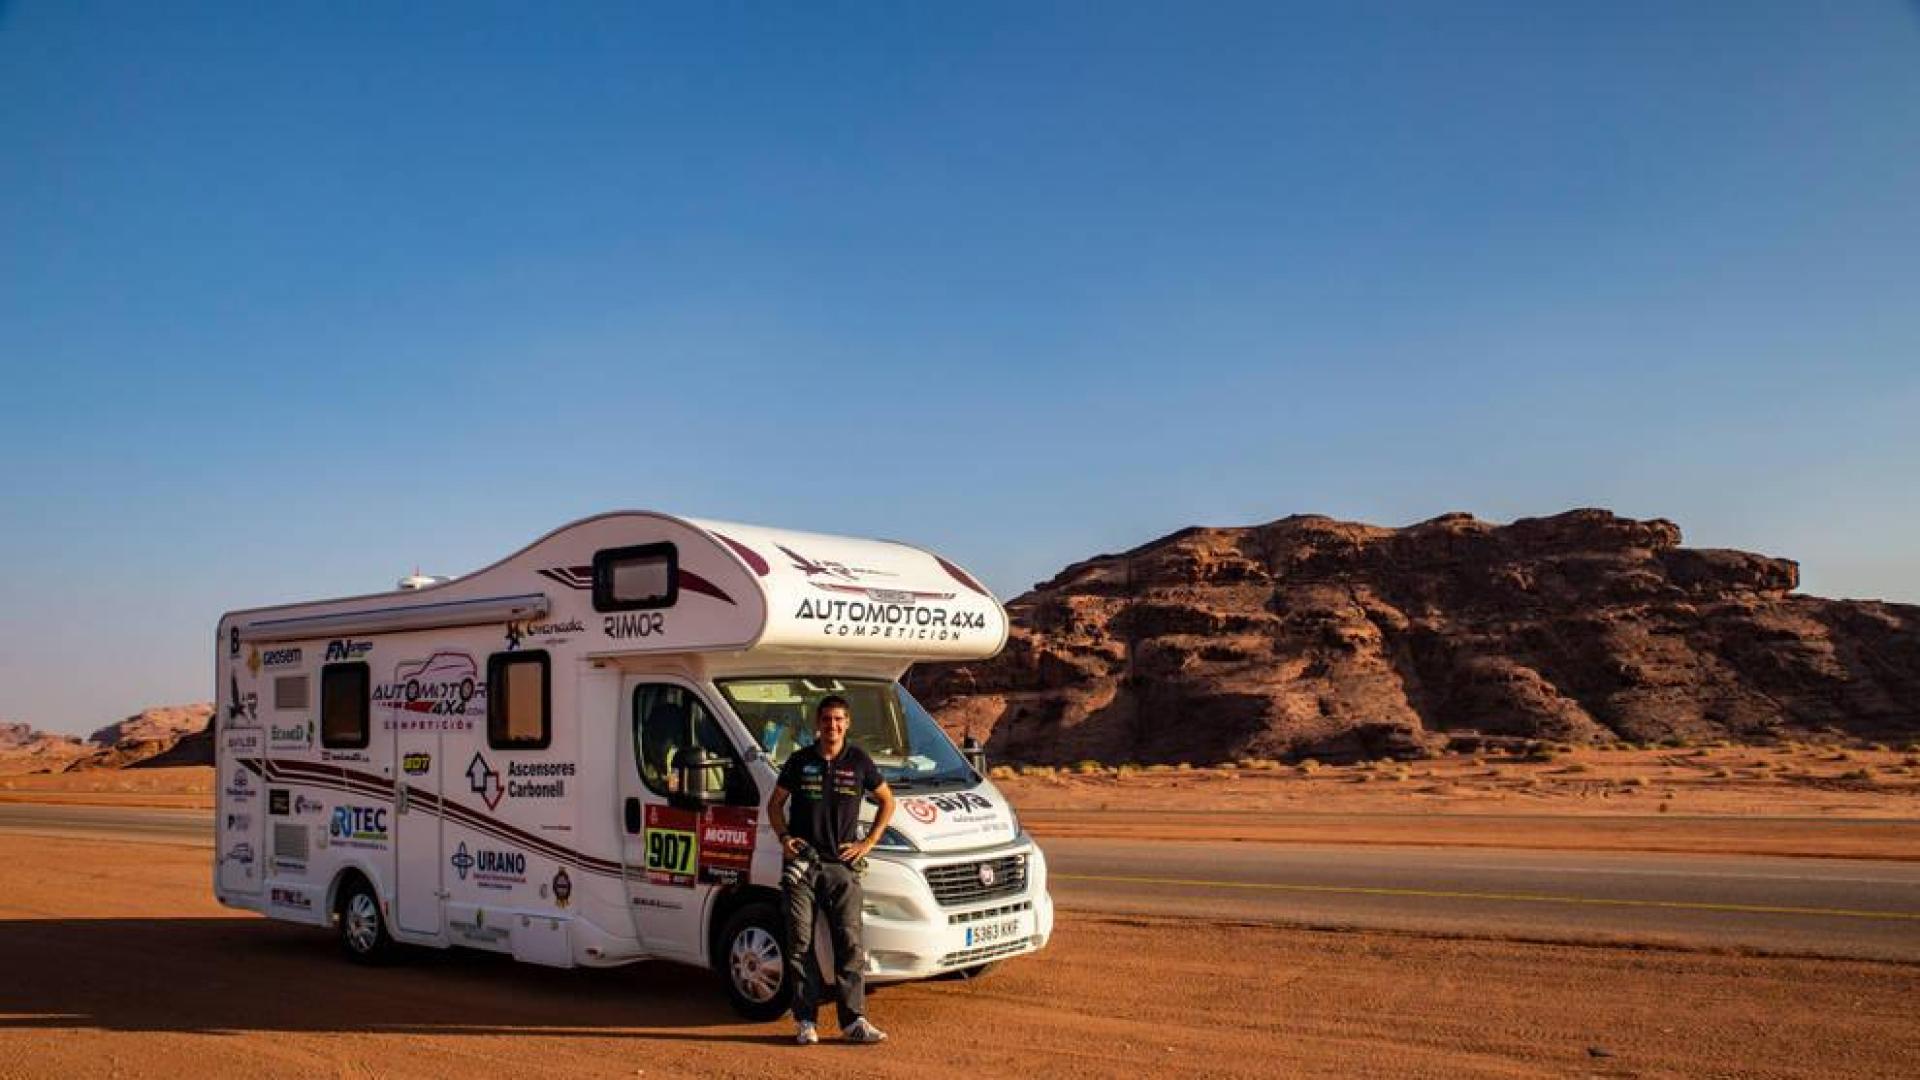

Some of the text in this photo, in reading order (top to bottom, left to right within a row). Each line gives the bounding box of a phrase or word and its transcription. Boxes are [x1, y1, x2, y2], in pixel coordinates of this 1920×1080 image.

[604, 612, 664, 638] RIMOR
[795, 598, 986, 629] AUTOMOTOR 4X4
[372, 679, 488, 702] AUTOMOTOR
[508, 761, 576, 777] Ascensores
[508, 780, 565, 798] Carbonell
[705, 828, 750, 845] MOTUL
[477, 850, 526, 875] URANO
[649, 831, 692, 872] 907
